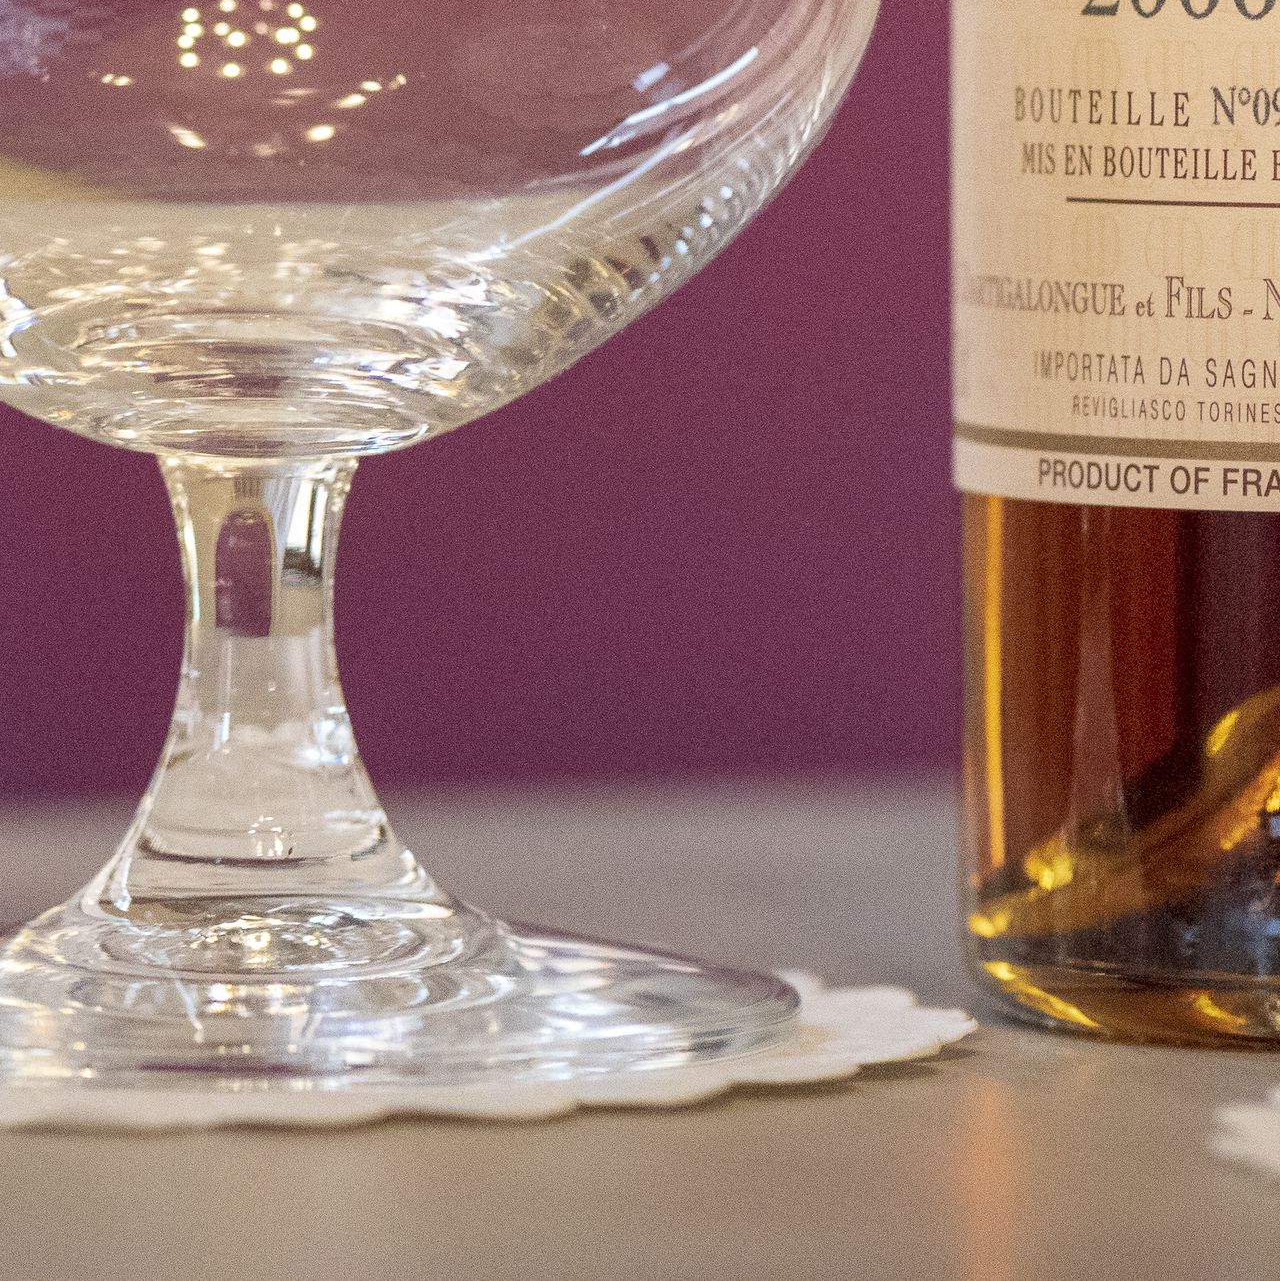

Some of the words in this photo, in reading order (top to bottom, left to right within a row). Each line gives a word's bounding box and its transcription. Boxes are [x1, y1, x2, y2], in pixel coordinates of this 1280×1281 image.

[1014, 86, 1191, 127] BOUTEILLE
[1021, 141, 1056, 175] MIS
[1064, 144, 1094, 177] EN
[1103, 146, 1258, 182] BOUTEILLE
[963, 274, 1126, 317] TIGALONGUE
[1135, 292, 1156, 318] et
[1164, 275, 1233, 321] FILS
[1033, 350, 1146, 386] IMPORTATA
[1159, 356, 1191, 387] DA
[1072, 394, 1187, 422] REVIGLIASCO
[1037, 458, 1160, 495] PRODUCT
[1169, 466, 1211, 497] OF
